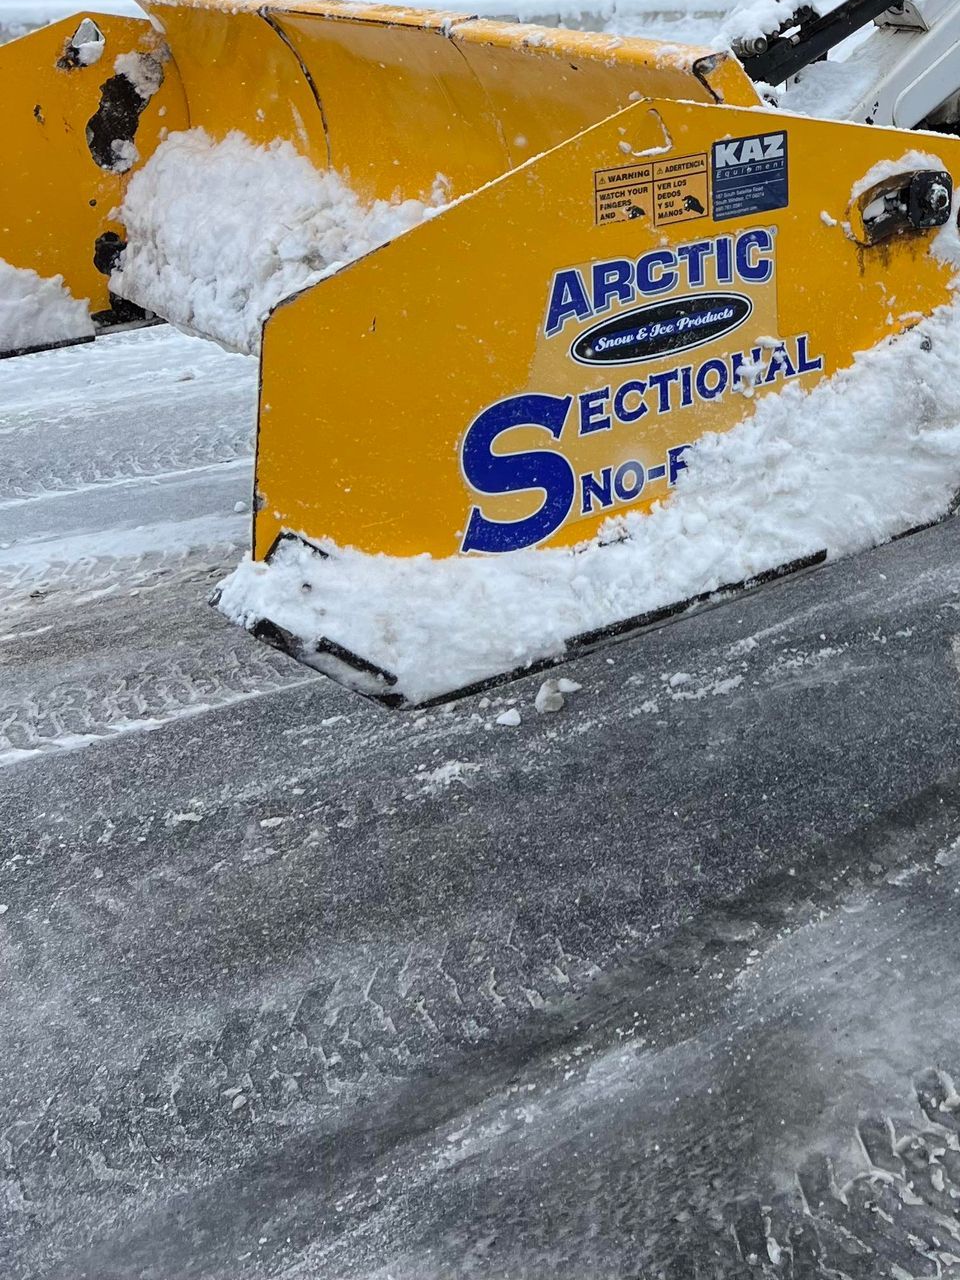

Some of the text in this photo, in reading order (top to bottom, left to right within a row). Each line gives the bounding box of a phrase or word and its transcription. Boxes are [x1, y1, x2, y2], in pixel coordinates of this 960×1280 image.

[715, 134, 784, 168] KAZ
[664, 159, 705, 173] ADERTENCIA
[716, 160, 784, 179] Equipment
[607, 169, 650, 183] WARNING
[657, 179, 687, 191] VER LOS
[599, 186, 649, 201] WATCH YOUR
[657, 190, 681, 200] DEDOS
[599, 199, 632, 211] FINGERS
[664, 200, 675, 208] SU
[600, 211, 616, 221] AND
[657, 208, 683, 219] MANOS
[544, 228, 775, 338] ARCTIC
[594, 306, 736, 353] Snow & Ice Products
